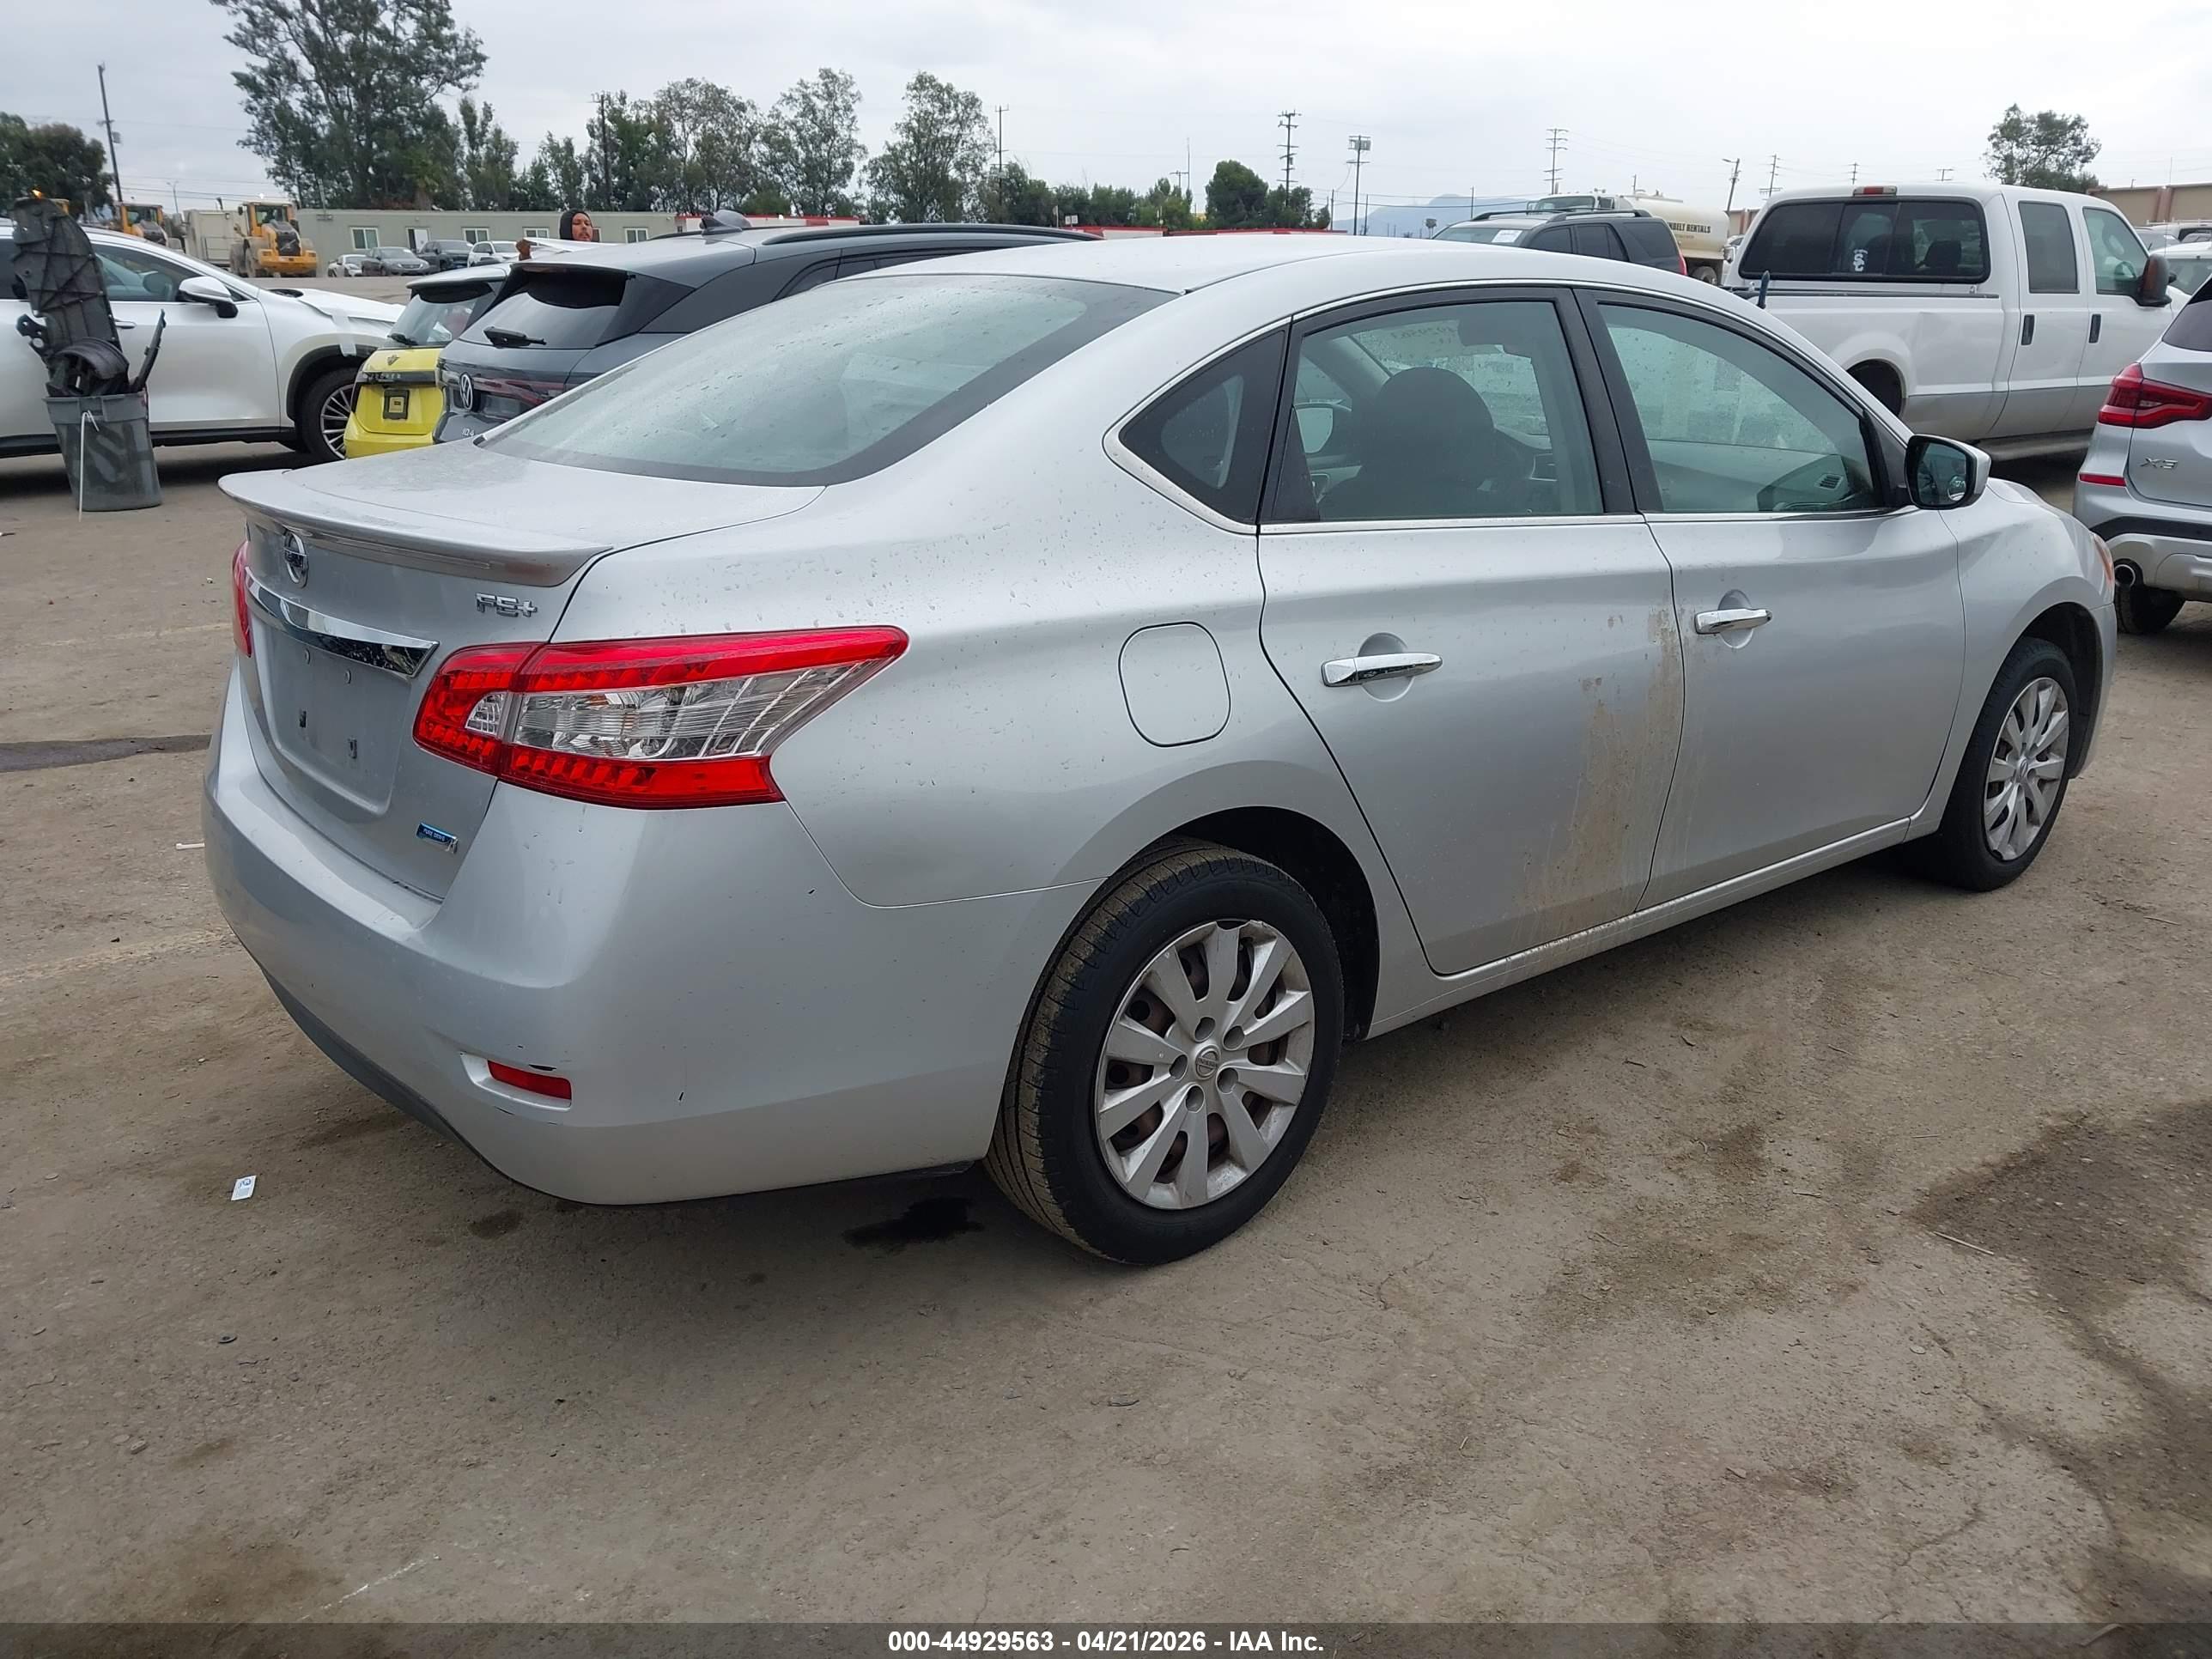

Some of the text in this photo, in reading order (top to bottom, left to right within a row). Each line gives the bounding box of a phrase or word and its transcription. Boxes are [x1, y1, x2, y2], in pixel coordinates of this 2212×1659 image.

[1686, 224, 1711, 234] RENTALS
[2140, 457, 2179, 471] X3
[475, 592, 538, 618] FE+
